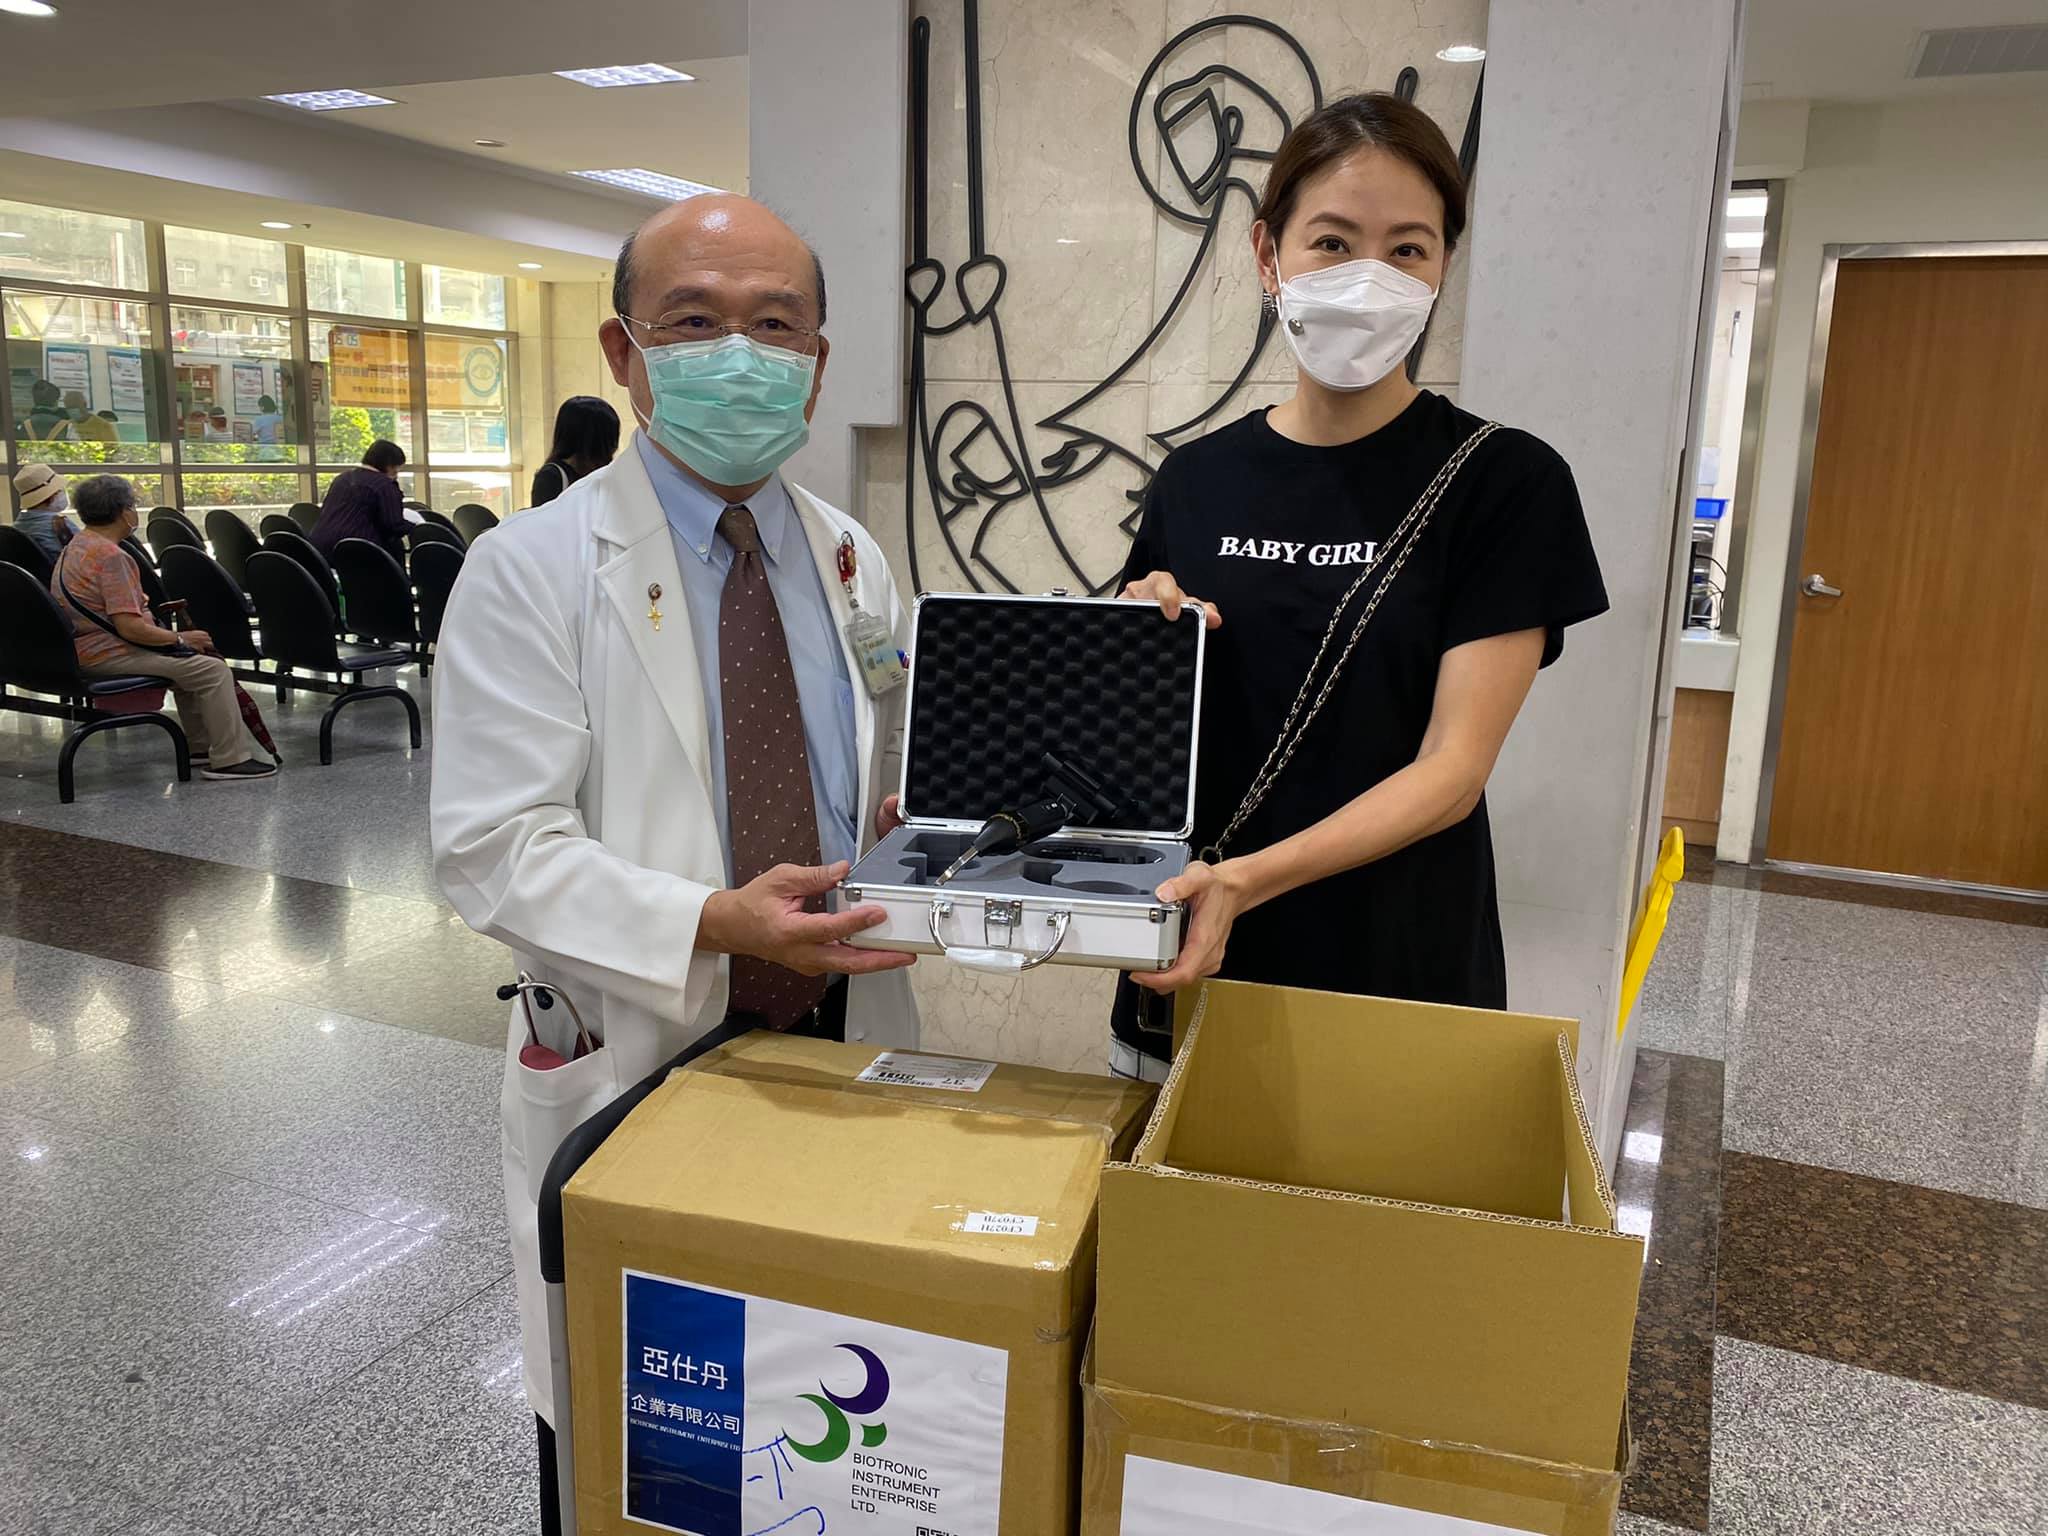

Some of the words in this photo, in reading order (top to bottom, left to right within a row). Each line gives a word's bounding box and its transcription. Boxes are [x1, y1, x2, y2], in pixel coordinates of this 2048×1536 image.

[1217, 536, 1305, 564] BABY
[641, 1345, 729, 1391] 亞仕丹
[630, 1394, 741, 1435] 企業有限公司
[852, 1452, 929, 1481] BIOTRONIC
[851, 1468, 941, 1499] INSTRUMENT
[850, 1498, 880, 1515] LTD.
[851, 1484, 938, 1514] ENTERPRISE
